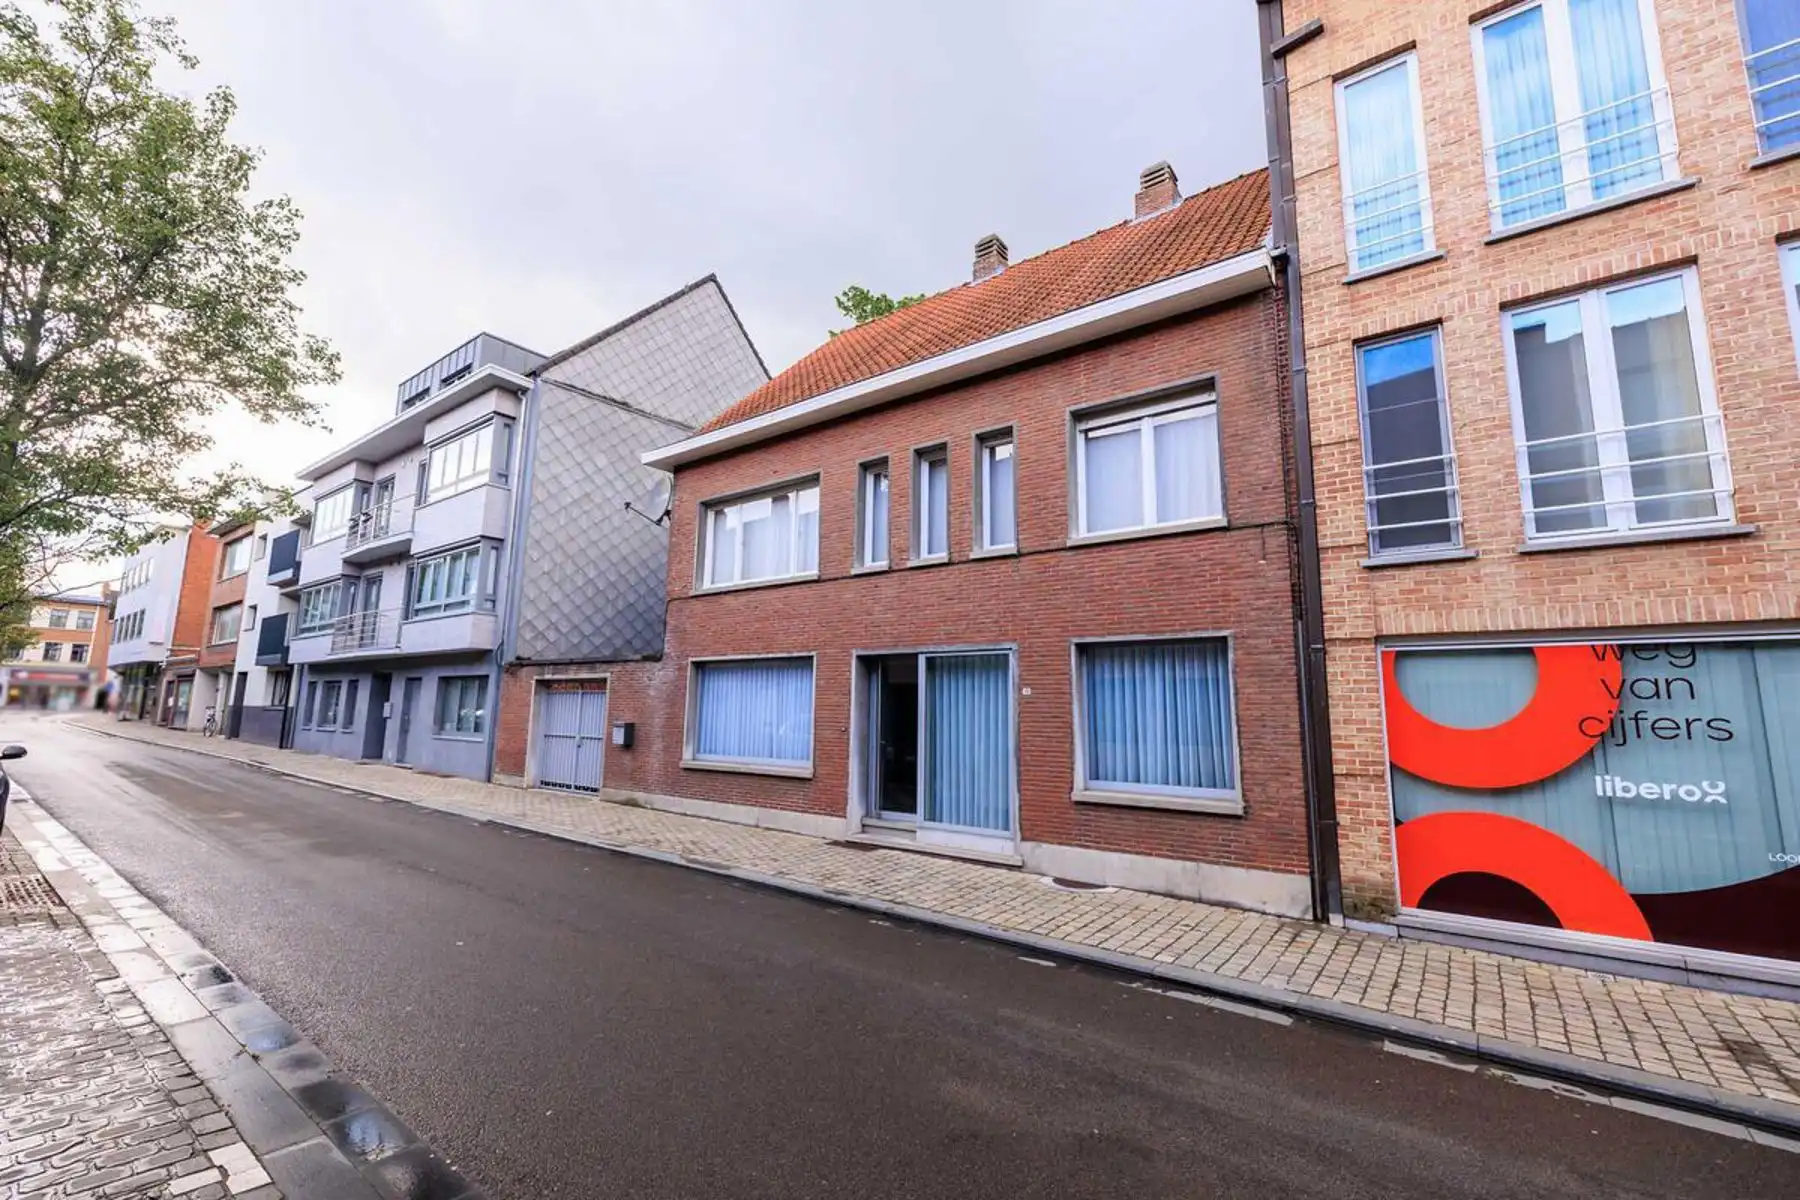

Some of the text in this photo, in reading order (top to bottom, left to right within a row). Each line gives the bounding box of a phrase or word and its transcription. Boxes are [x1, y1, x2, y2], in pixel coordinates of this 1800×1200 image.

[1591, 644, 1696, 668] weg
[1600, 678, 1695, 700] van
[1579, 710, 1733, 746] cijfers
[1595, 775, 1728, 804] liberox
[1768, 852, 1800, 864] LOO
